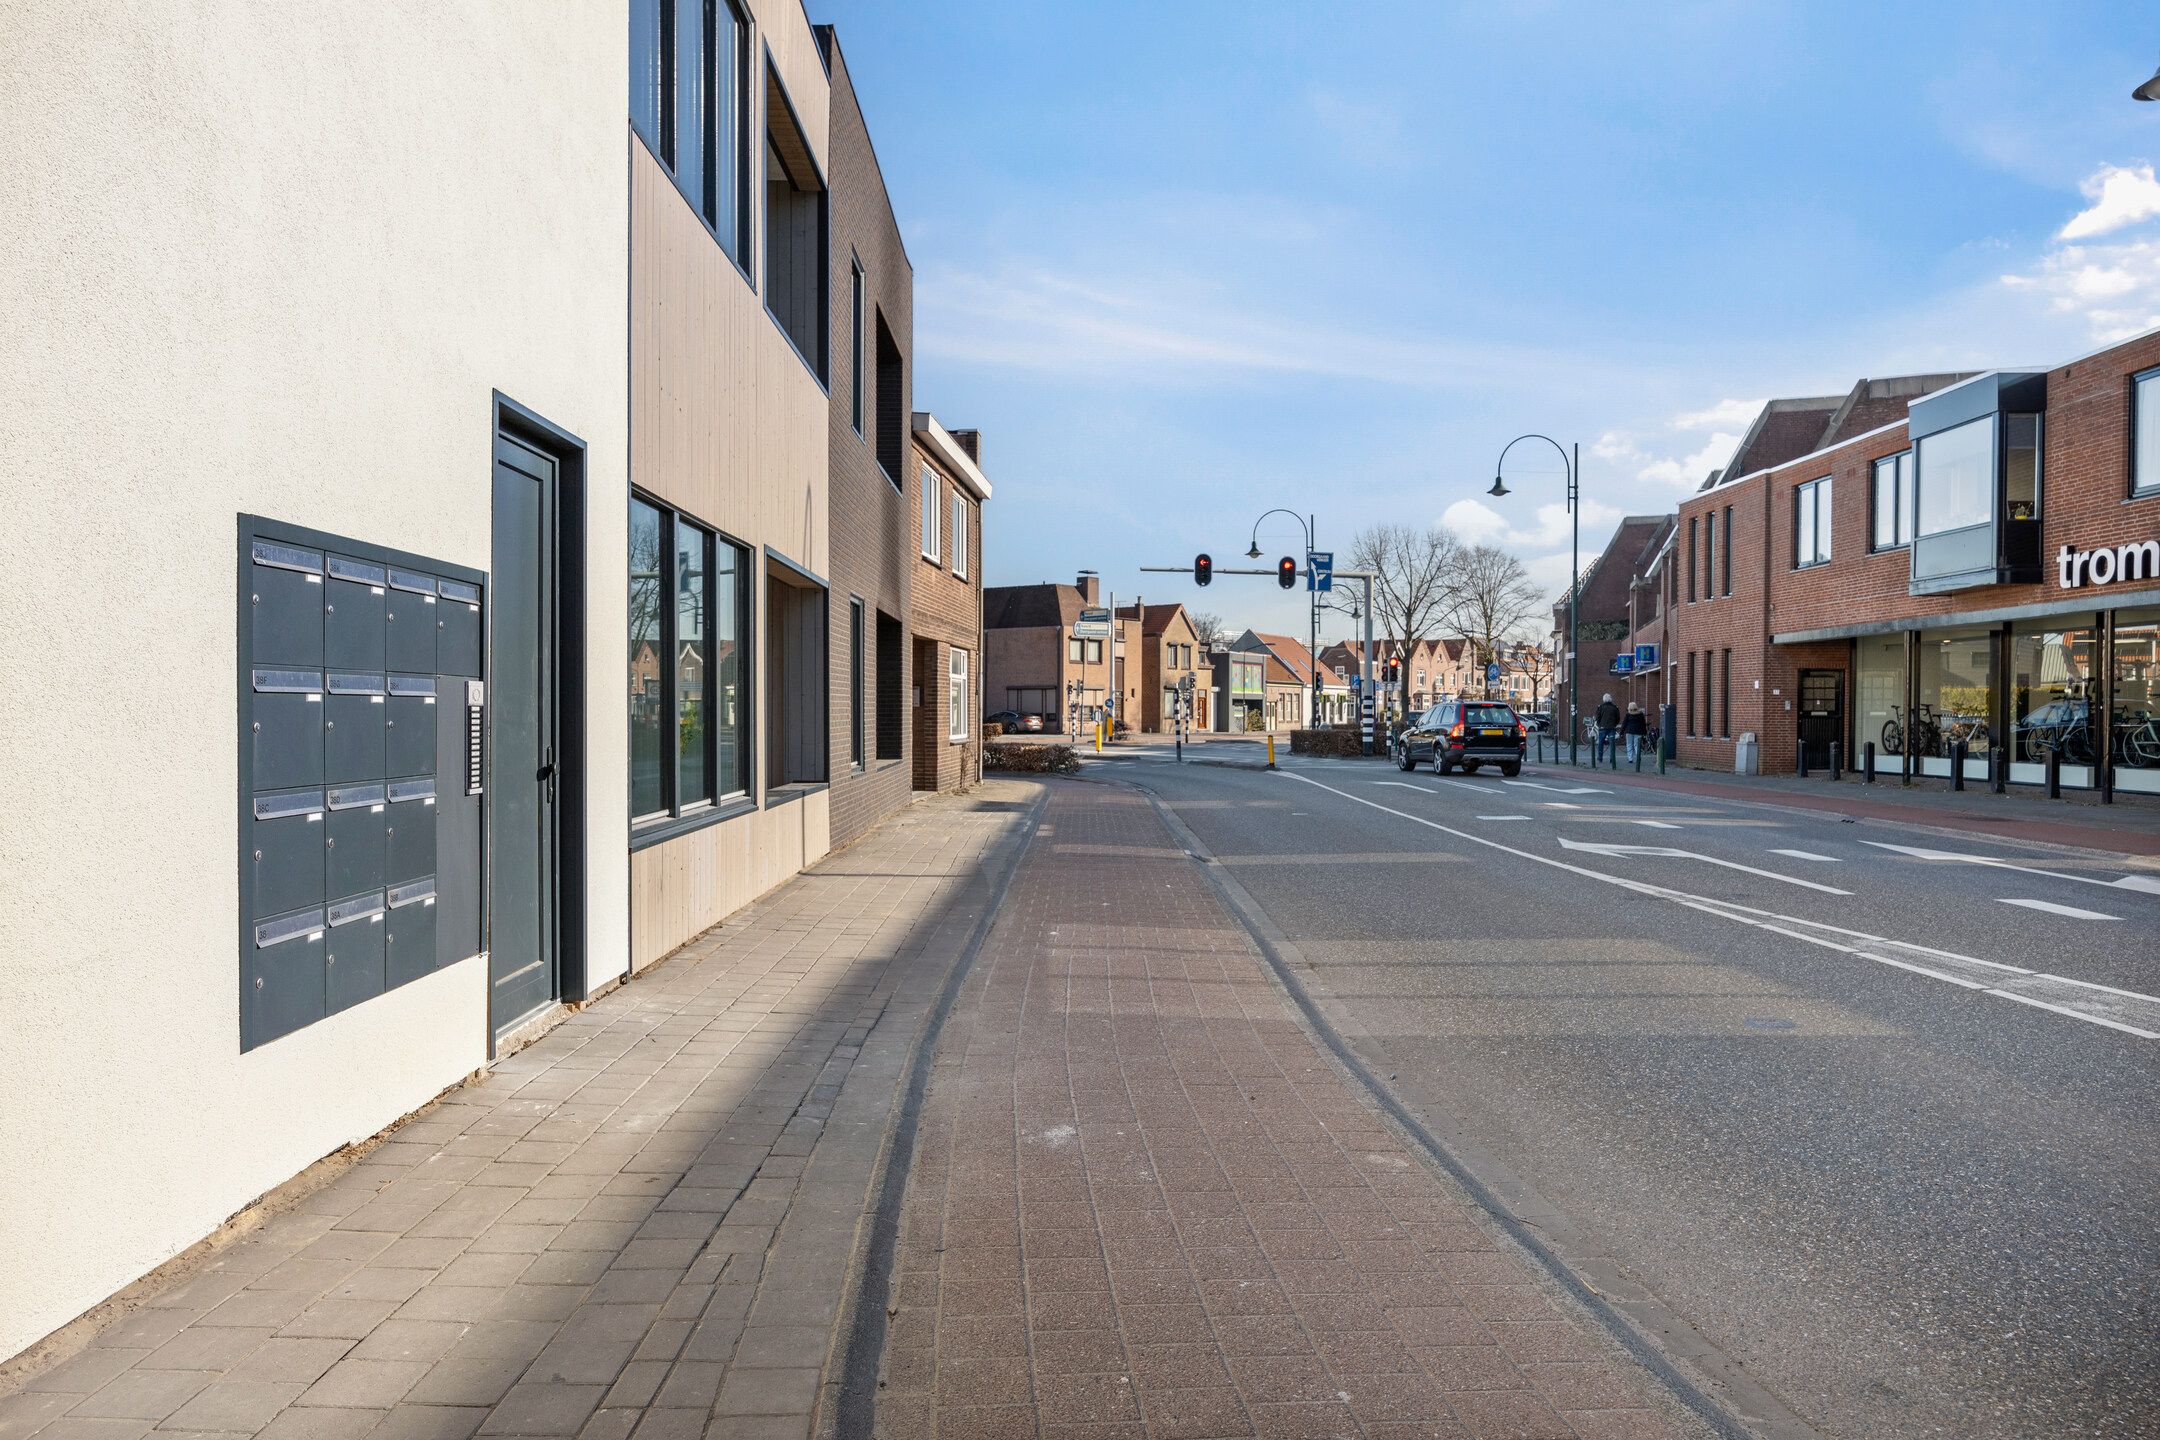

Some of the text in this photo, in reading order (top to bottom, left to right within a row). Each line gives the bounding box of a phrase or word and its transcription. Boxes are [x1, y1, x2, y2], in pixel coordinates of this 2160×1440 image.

[2056, 540, 2160, 589] trom
[256, 675, 269, 685] 38F
[330, 679, 341, 688] 38G
[330, 795, 341, 804] 38D
[257, 803, 270, 813] 38C
[330, 911, 341, 921] 38A
[258, 930, 268, 940] 38
